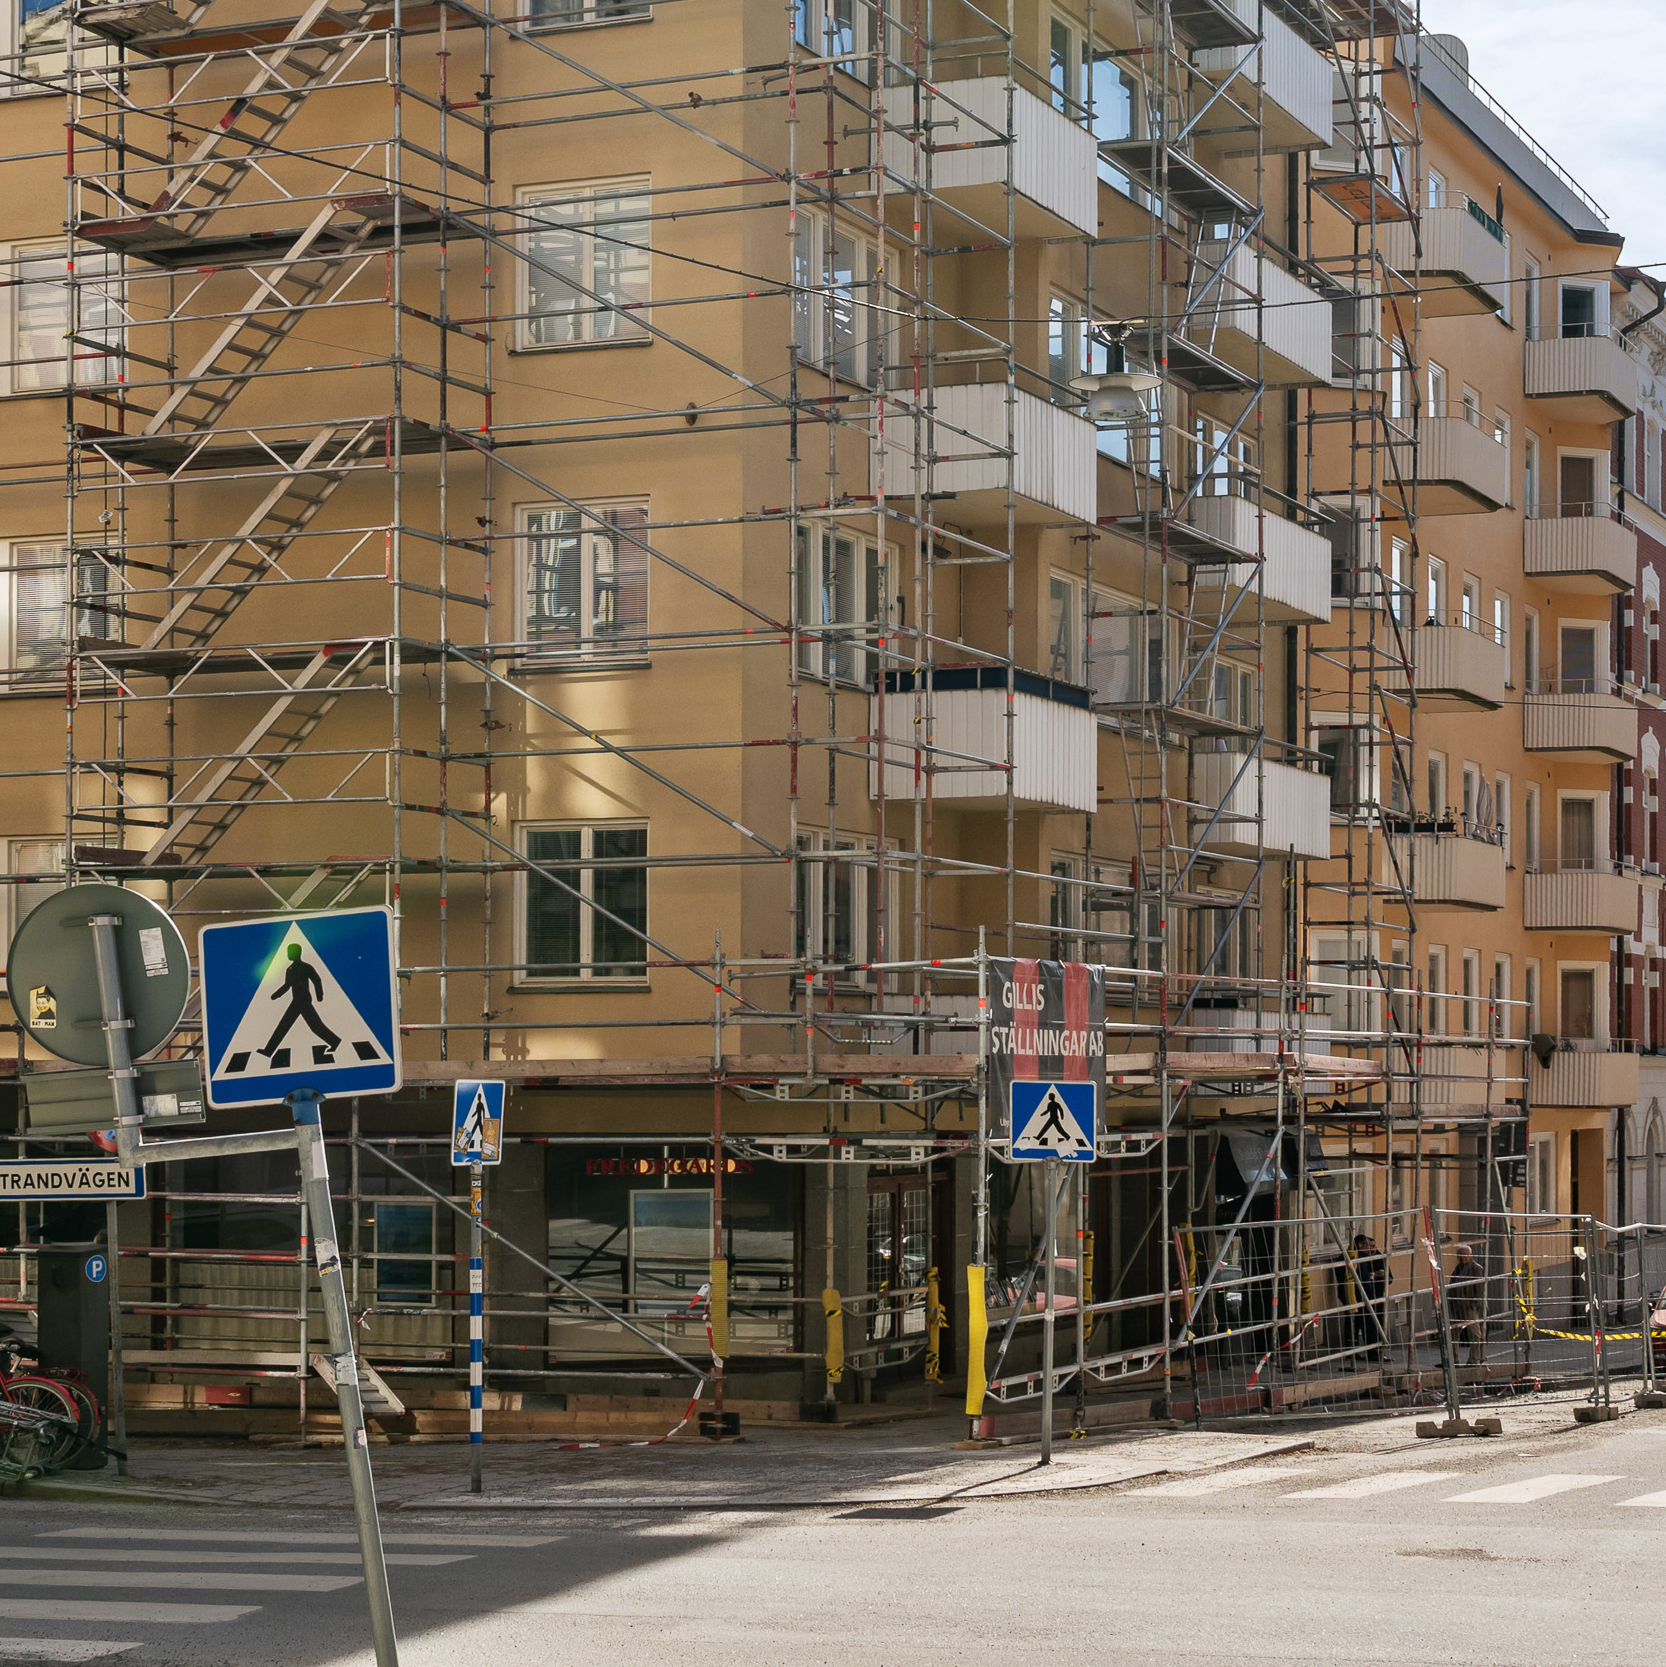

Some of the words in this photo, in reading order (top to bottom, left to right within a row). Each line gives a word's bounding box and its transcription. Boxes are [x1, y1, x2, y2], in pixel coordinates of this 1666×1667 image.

[1002, 981, 1045, 1011] GILLIS
[991, 1021, 1087, 1057] STÄLLNINGAR
[1089, 1030, 1104, 1057] AB
[92, 1260, 103, 1278] P
